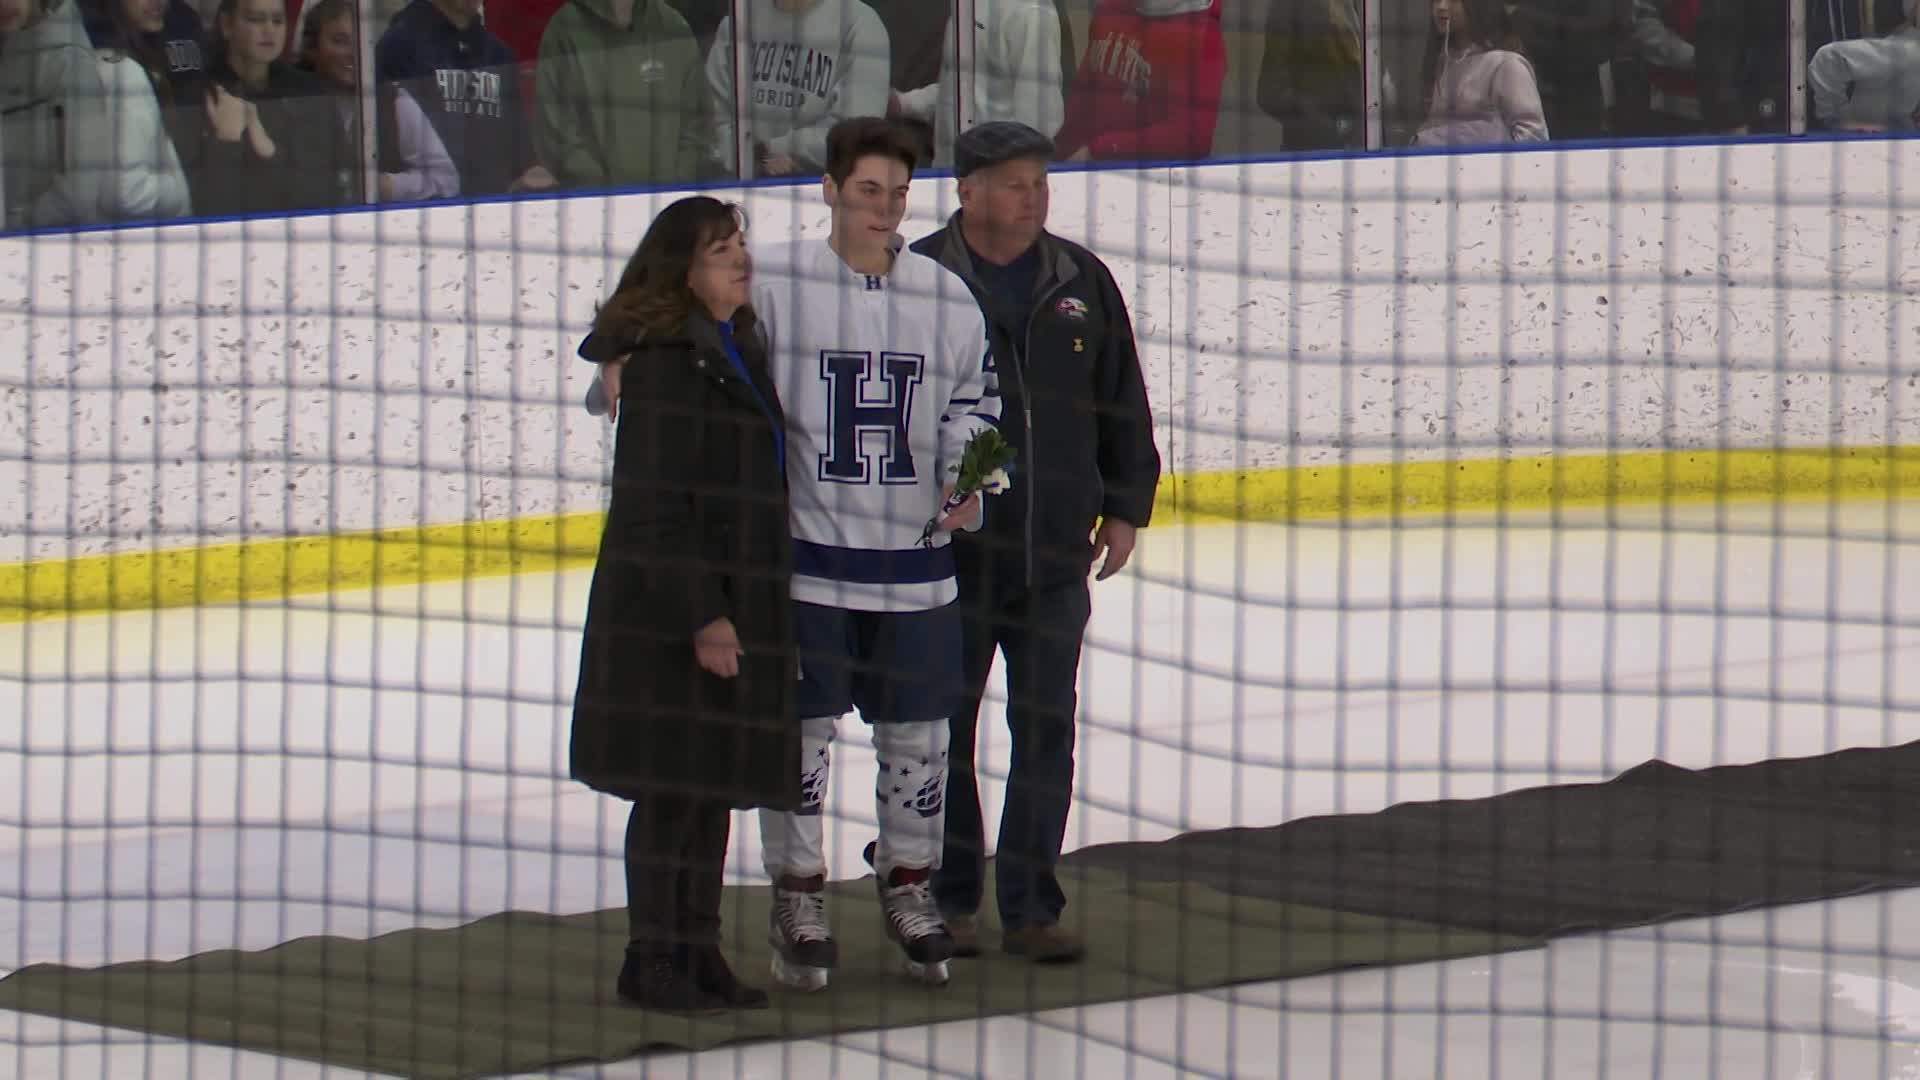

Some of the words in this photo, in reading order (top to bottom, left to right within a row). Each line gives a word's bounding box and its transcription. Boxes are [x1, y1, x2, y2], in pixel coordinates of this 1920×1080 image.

[775, 41, 834, 98] ISLAND
[865, 274, 882, 290] H
[817, 350, 925, 485] H
